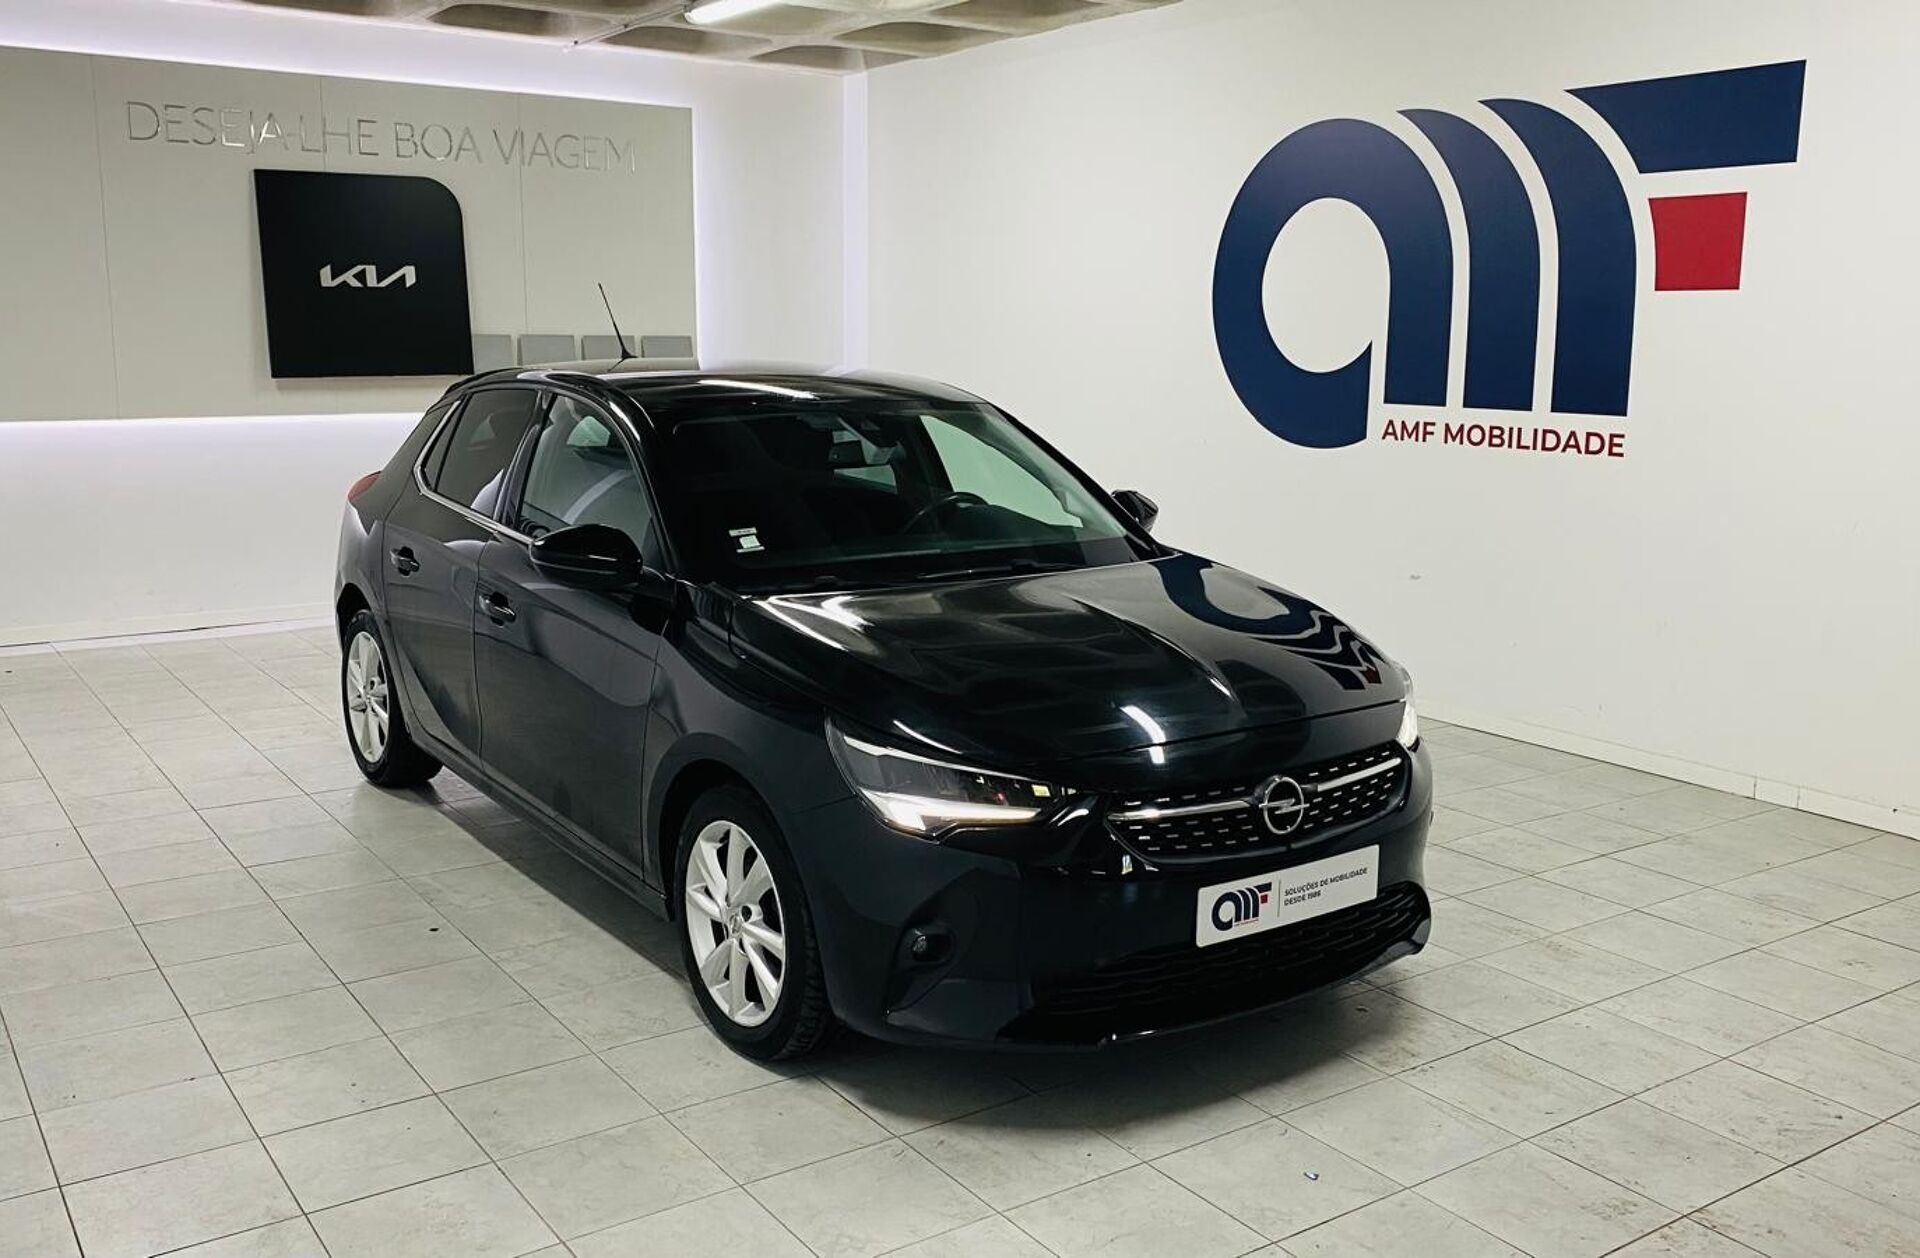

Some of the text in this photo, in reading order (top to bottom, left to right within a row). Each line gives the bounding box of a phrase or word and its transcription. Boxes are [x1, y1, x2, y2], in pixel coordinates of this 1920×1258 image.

[127, 101, 636, 175] DESEJA-LHE BOA VIAGEM
[320, 264, 416, 288] KIA
[1381, 419, 1626, 457] AMF MOBILIDADE
[1330, 867, 1368, 883] MOBILIDADE
